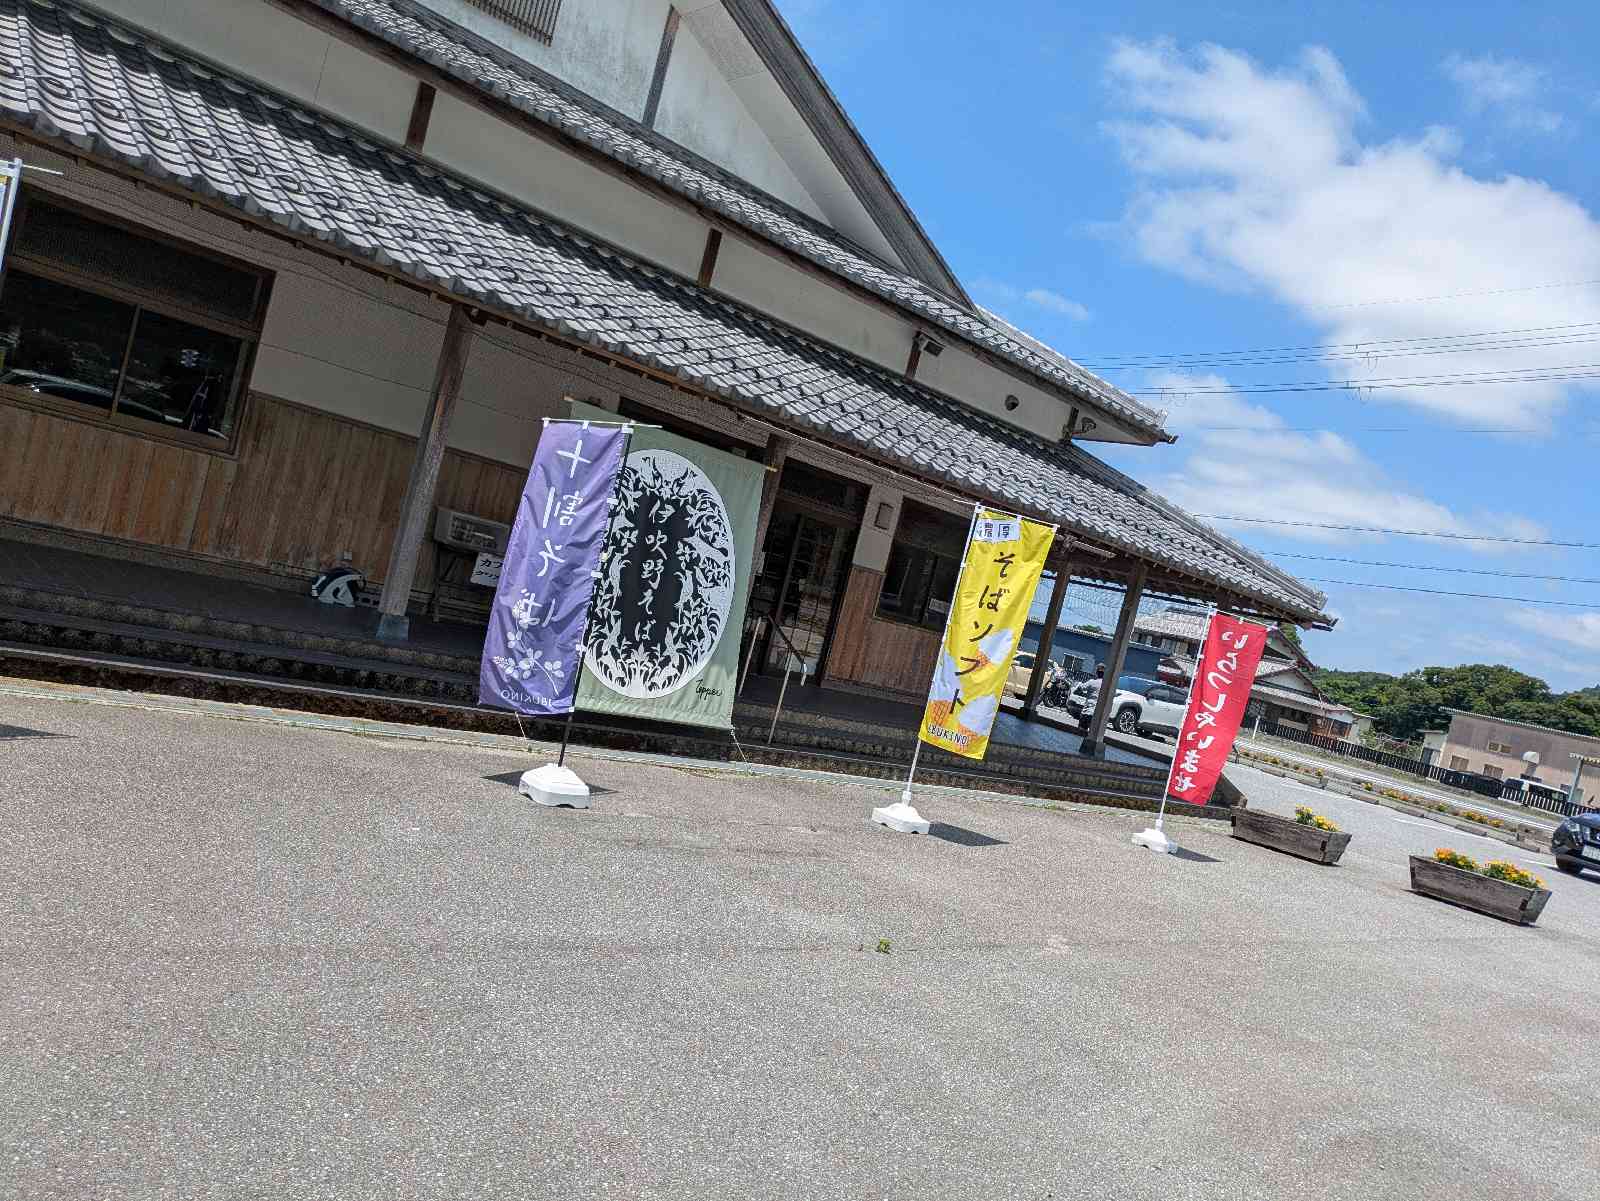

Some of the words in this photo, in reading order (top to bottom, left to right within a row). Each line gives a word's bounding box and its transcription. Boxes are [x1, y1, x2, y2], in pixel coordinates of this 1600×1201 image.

[635, 500, 676, 641] 伊吹野そば
[949, 551, 1015, 714] そばソフト
